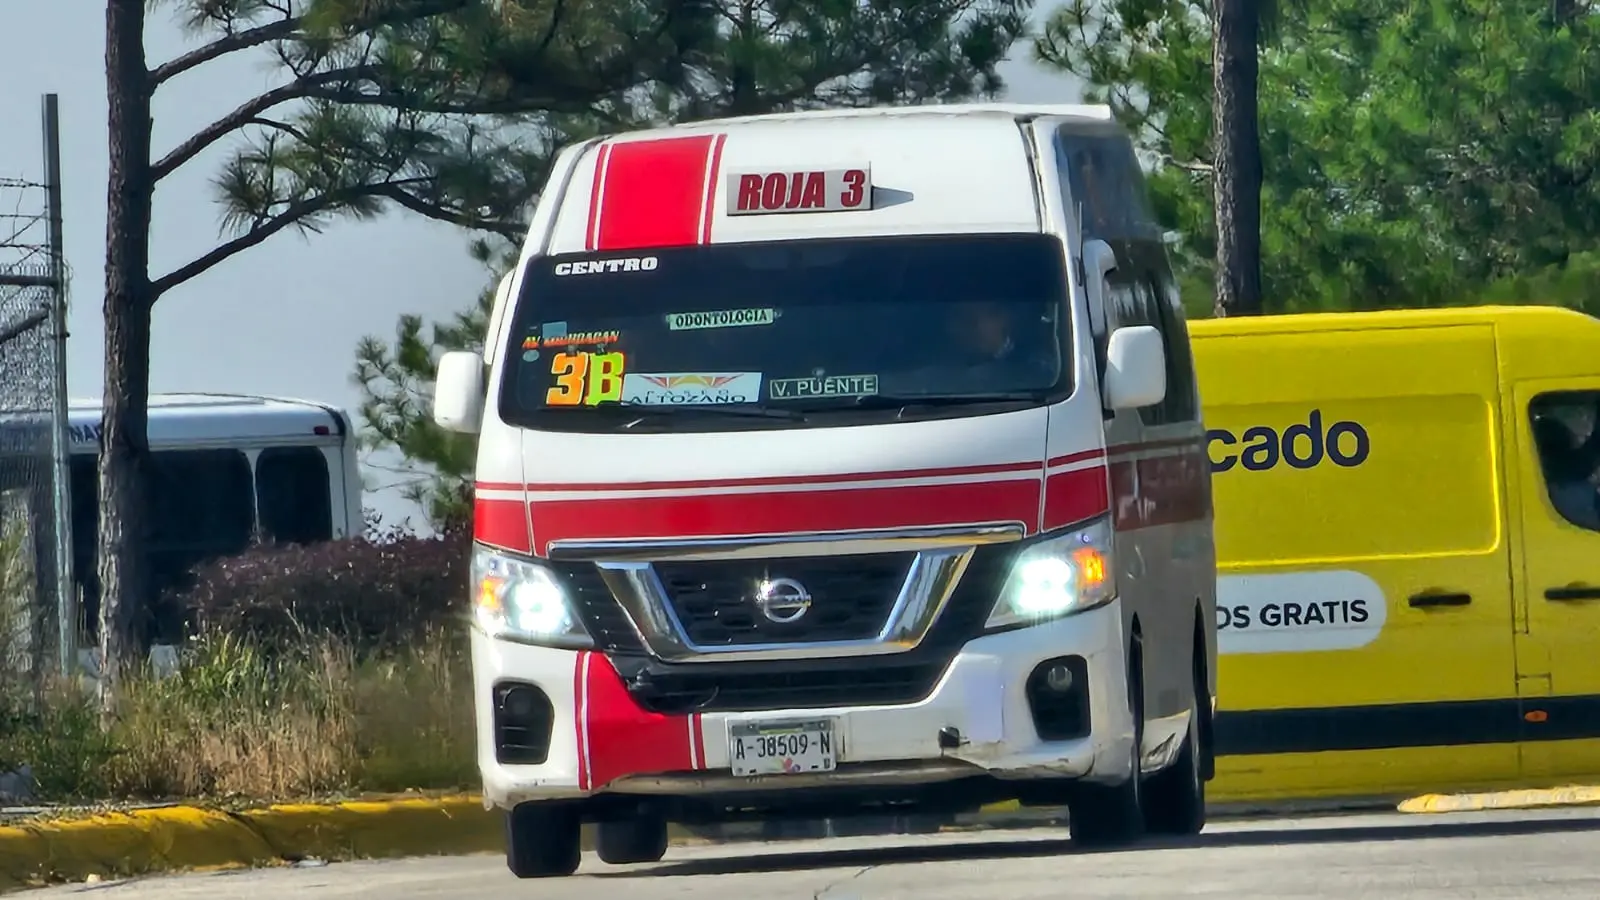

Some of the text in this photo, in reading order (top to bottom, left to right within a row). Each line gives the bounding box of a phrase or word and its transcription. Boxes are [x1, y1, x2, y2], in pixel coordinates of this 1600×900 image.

[737, 169, 866, 210] ROJA 3
[555, 256, 658, 275] CENTRO
[675, 309, 768, 327] ODONTOLOGIA
[546, 352, 627, 408] 3B
[774, 378, 875, 396] V. PUENTE
[631, 393, 747, 404] ALTOZANO
[1206, 408, 1370, 472] cado
[1259, 599, 1369, 627] GRATIS
[736, 731, 830, 760] A-38509-N
